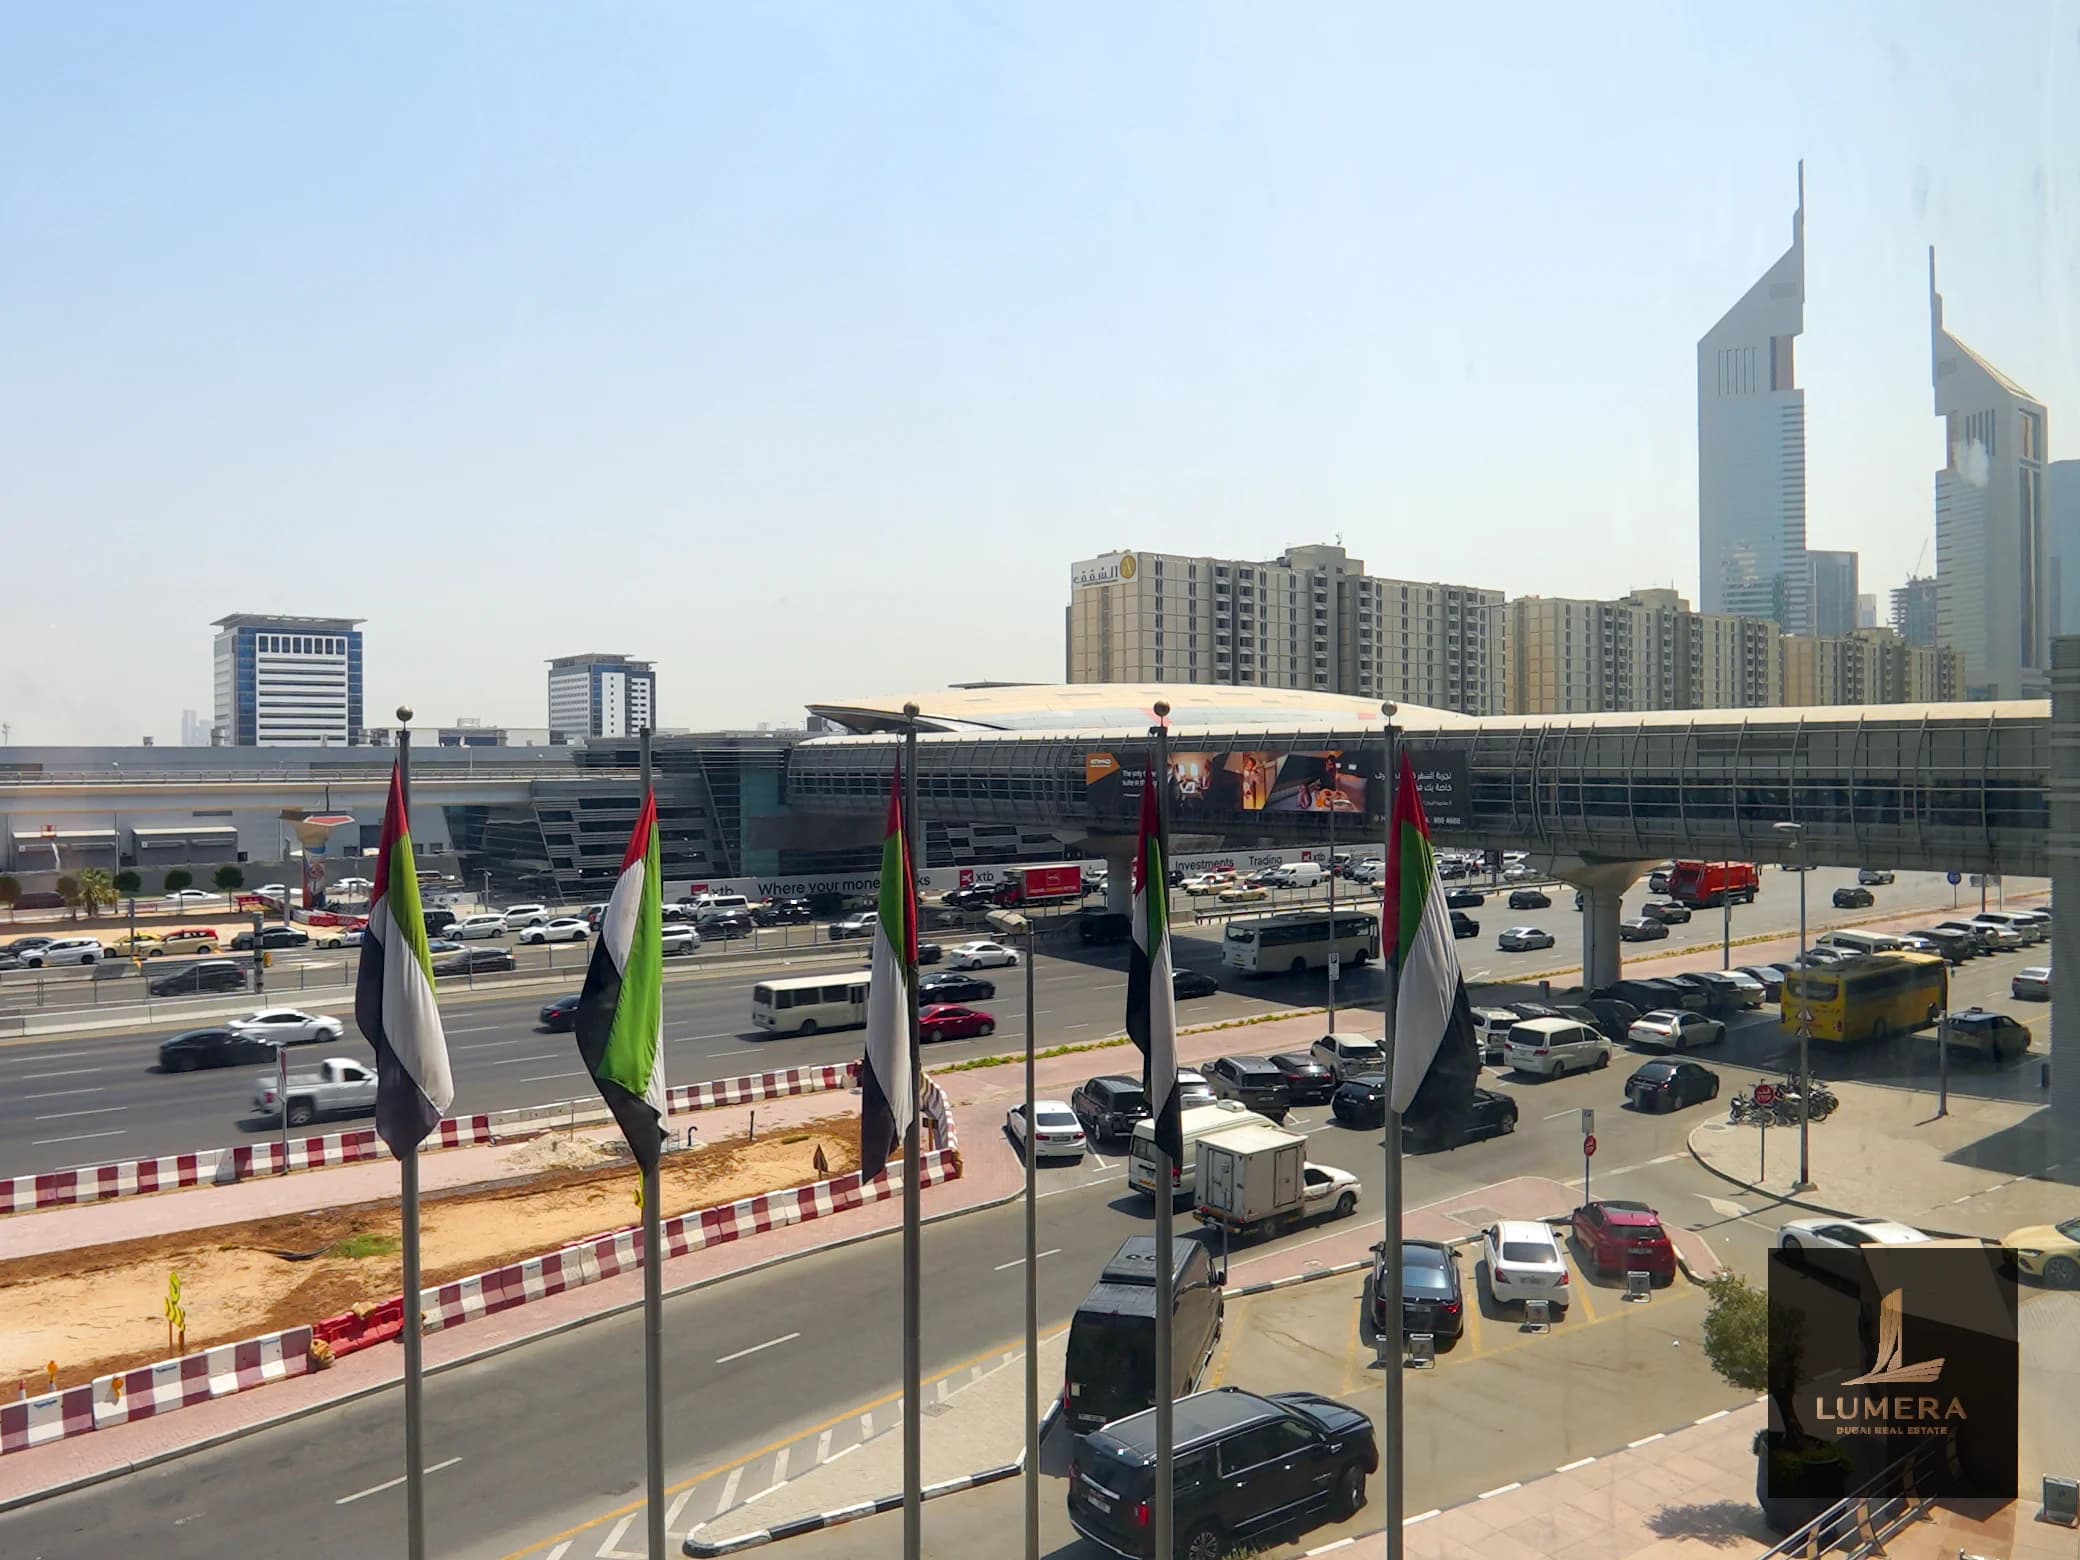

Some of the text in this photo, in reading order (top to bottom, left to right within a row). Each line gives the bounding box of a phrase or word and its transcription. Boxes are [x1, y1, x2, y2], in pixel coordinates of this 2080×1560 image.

[1175, 854, 1283, 871] Investments Trading
[976, 869, 995, 882] xtb
[758, 878, 881, 895] Where your mone
